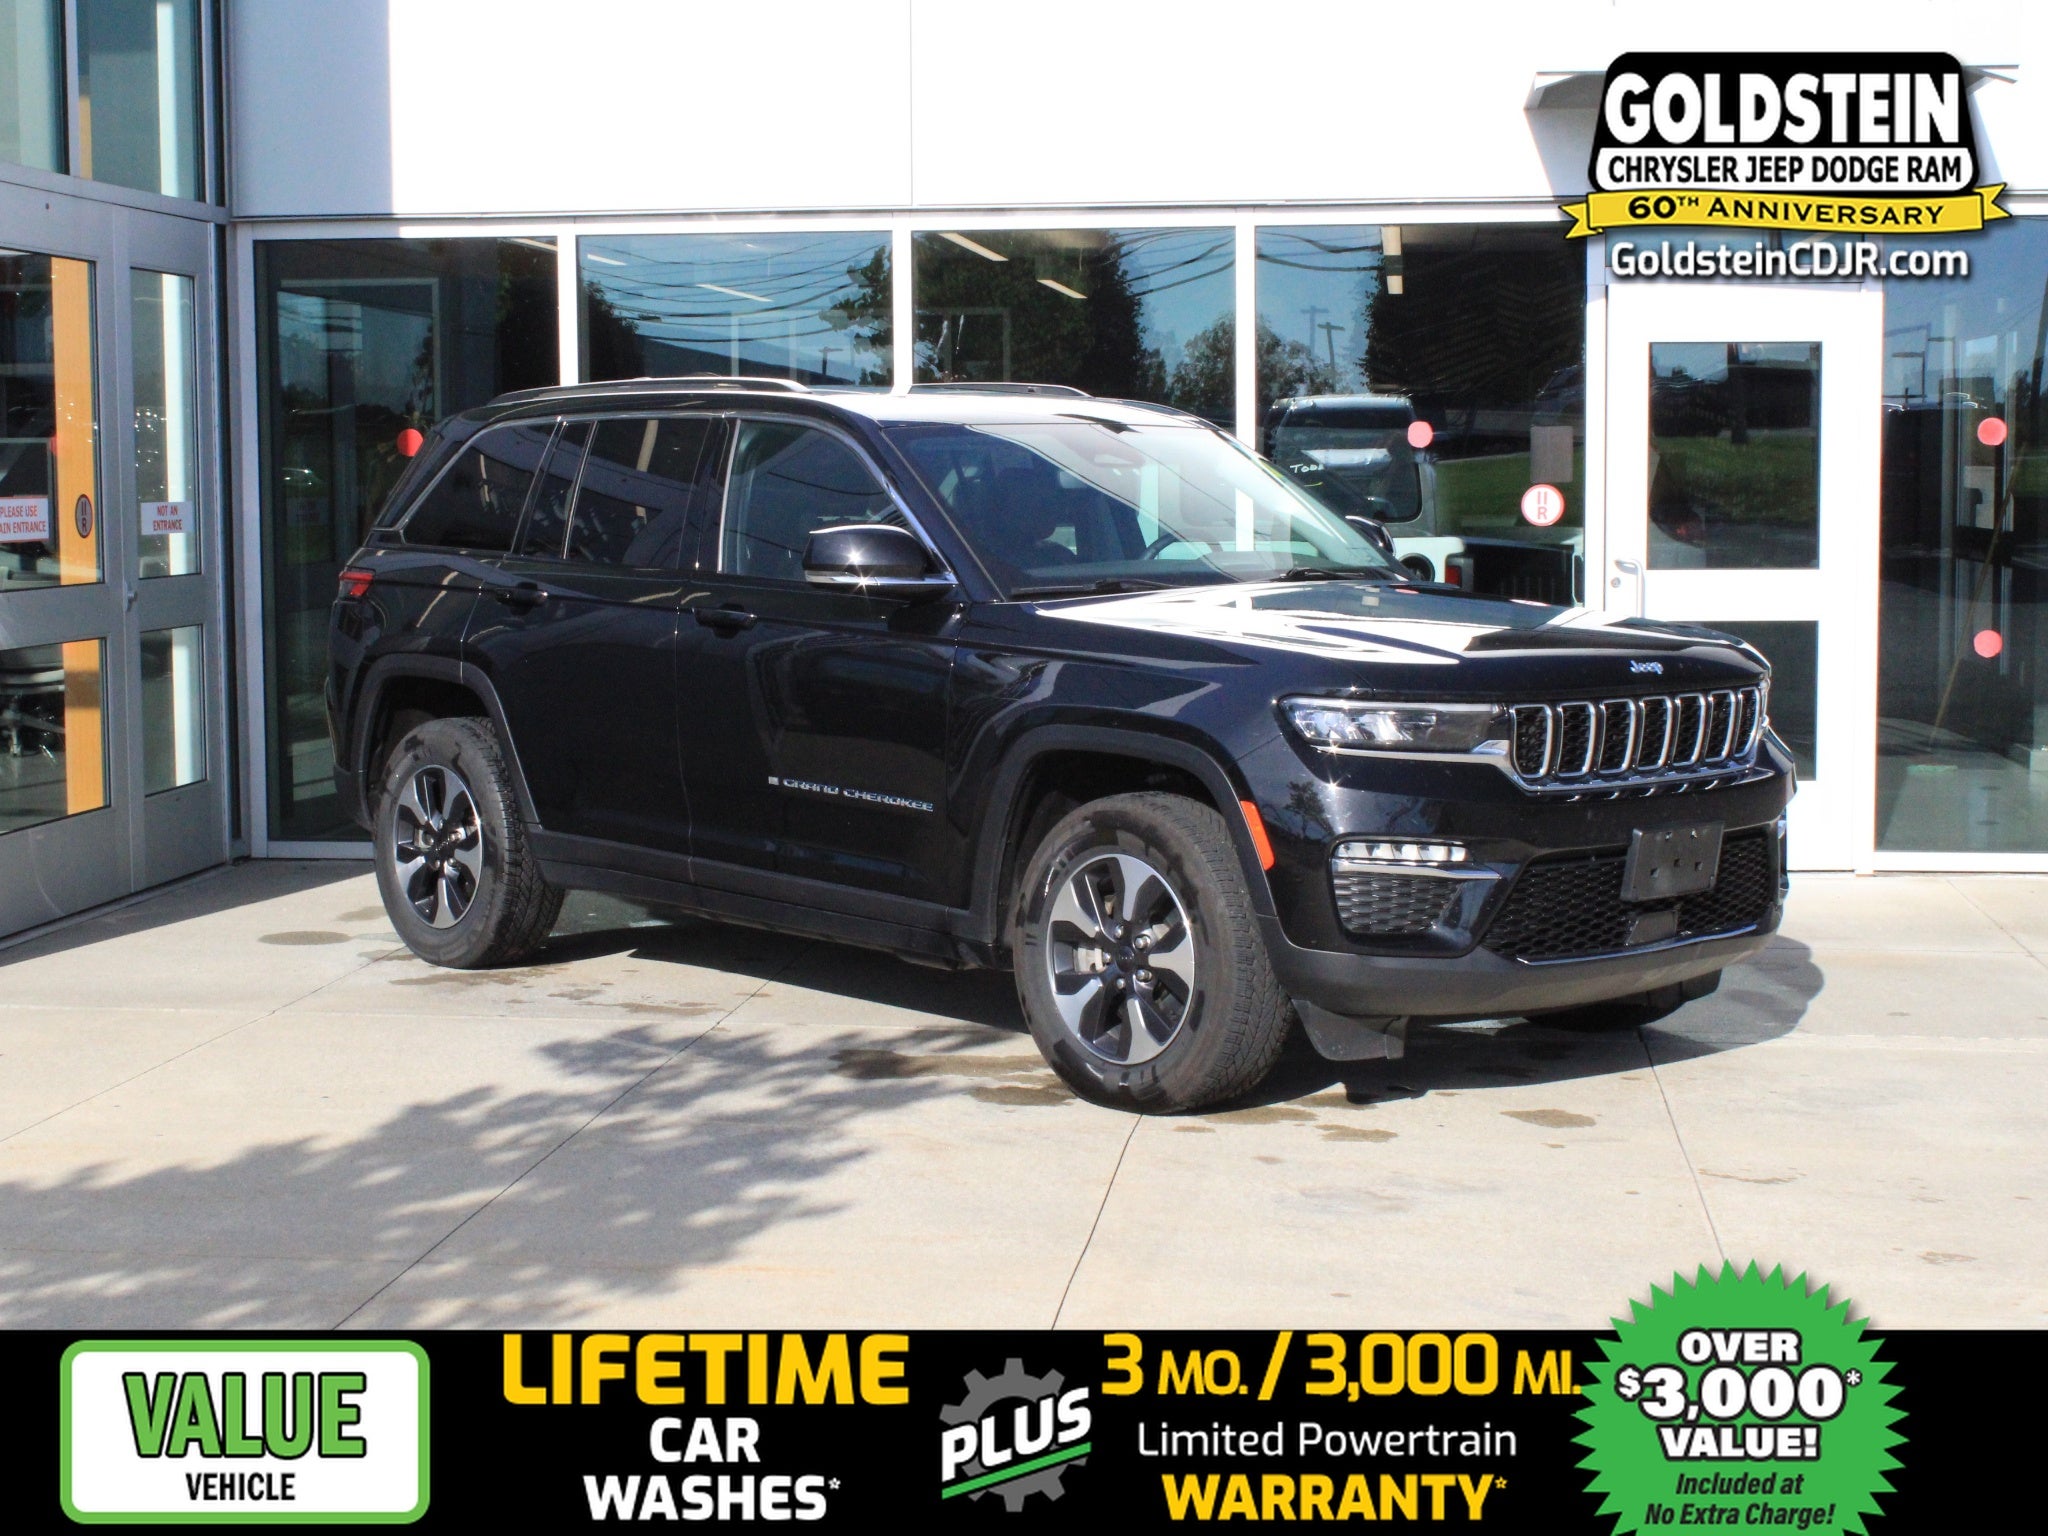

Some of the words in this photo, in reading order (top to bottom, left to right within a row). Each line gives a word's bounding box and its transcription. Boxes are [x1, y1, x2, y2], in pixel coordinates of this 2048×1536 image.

[25, 505, 38, 516] USE
[157, 505, 168, 516] NOT
[170, 505, 178, 515] AN
[0, 522, 11, 533] AIN
[13, 521, 46, 533] ENTRANCE
[153, 519, 183, 531] ENTRANCE
[1630, 660, 1664, 675] Jeep
[783, 778, 839, 795] GRAND
[843, 788, 934, 812] CHEROKEE
